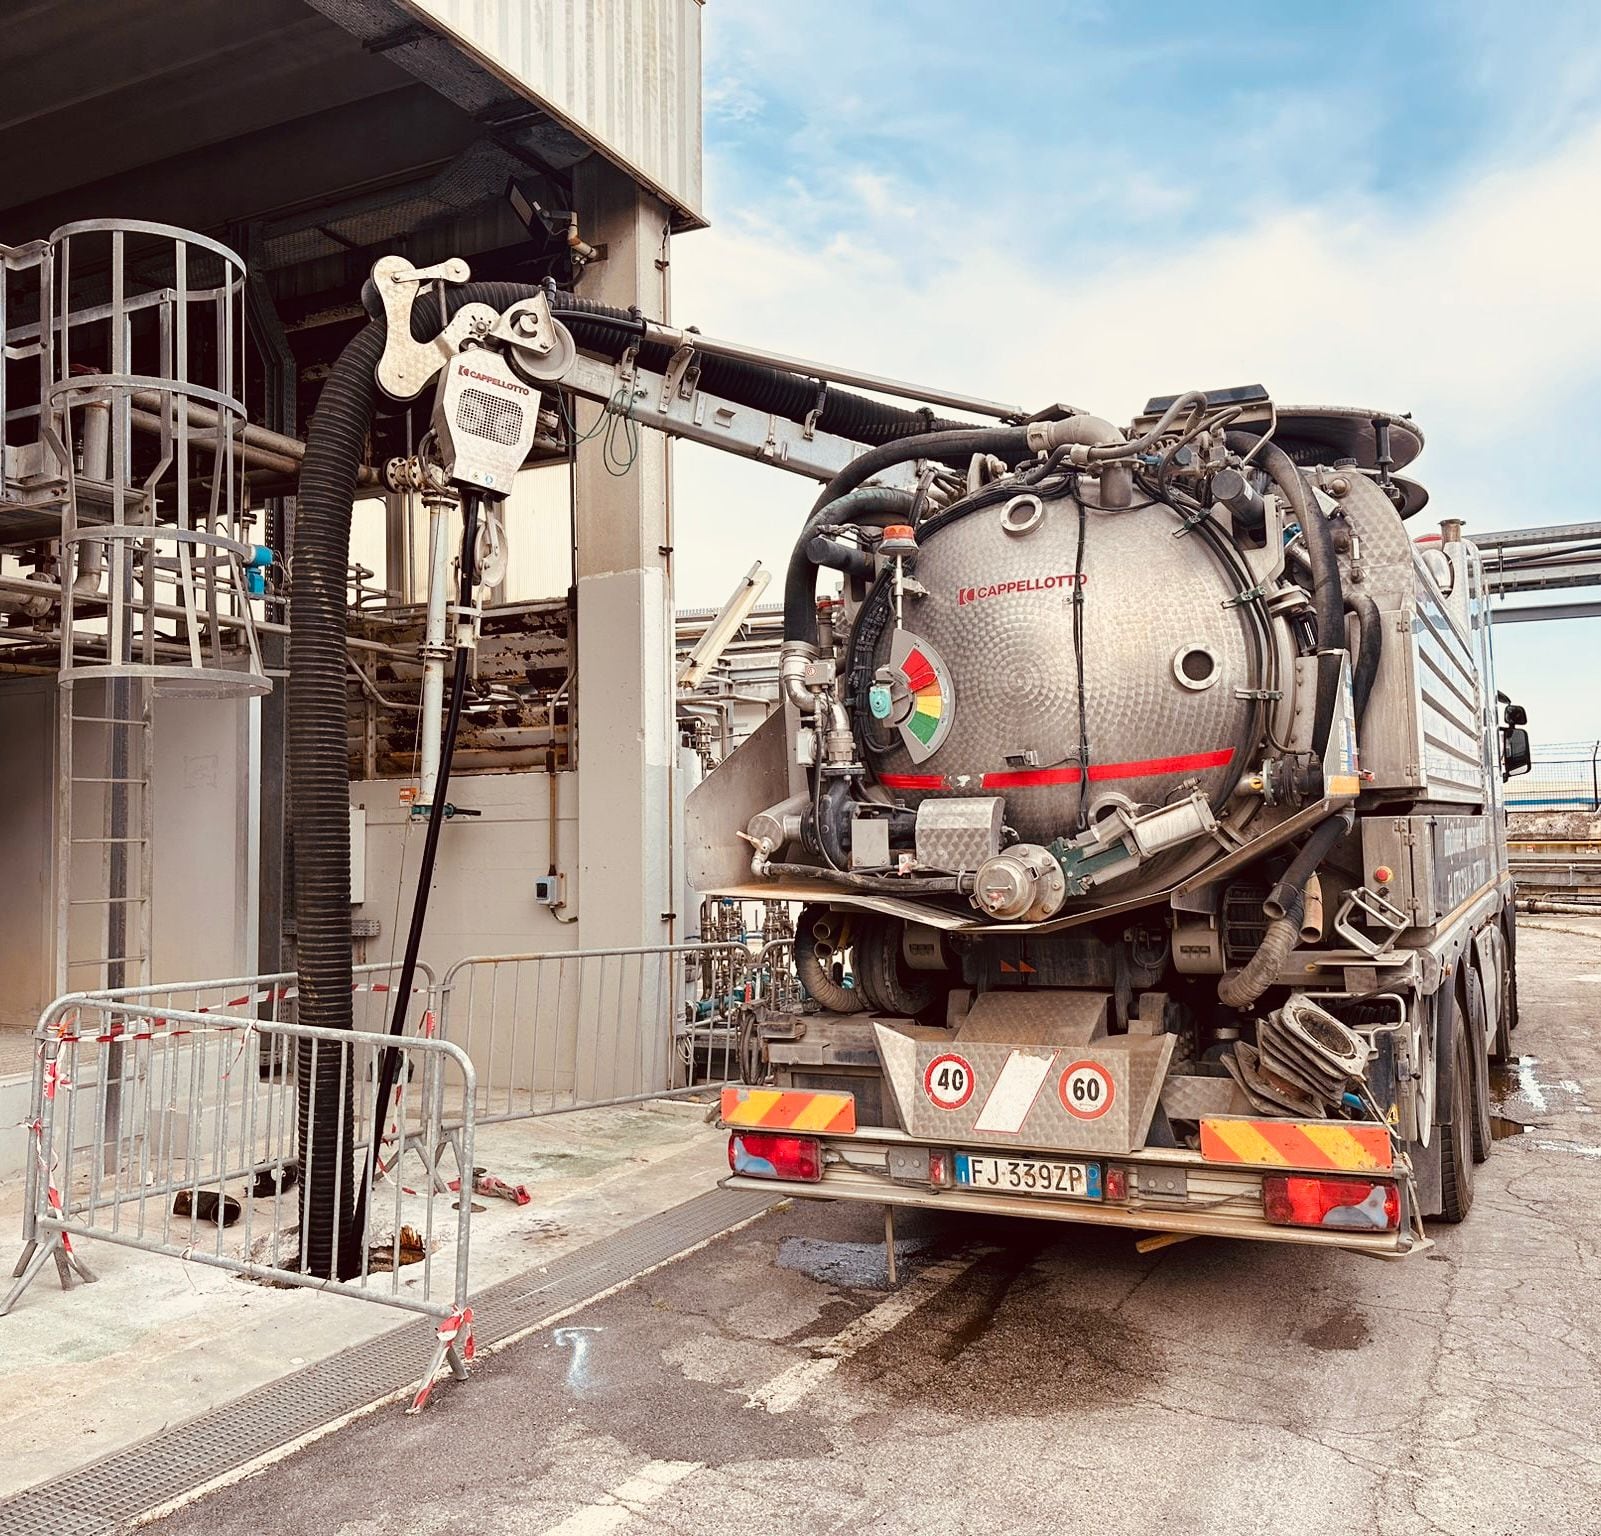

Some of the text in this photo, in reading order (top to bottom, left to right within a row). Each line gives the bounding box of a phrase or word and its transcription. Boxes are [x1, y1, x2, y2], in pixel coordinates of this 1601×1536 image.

[469, 371, 530, 396] CAPPELLOTTO
[937, 1068, 964, 1092] 40
[1072, 1077, 1100, 1102] 60
[971, 1159, 999, 1185] FJ
[1008, 1162, 1083, 1192] 339ZP
